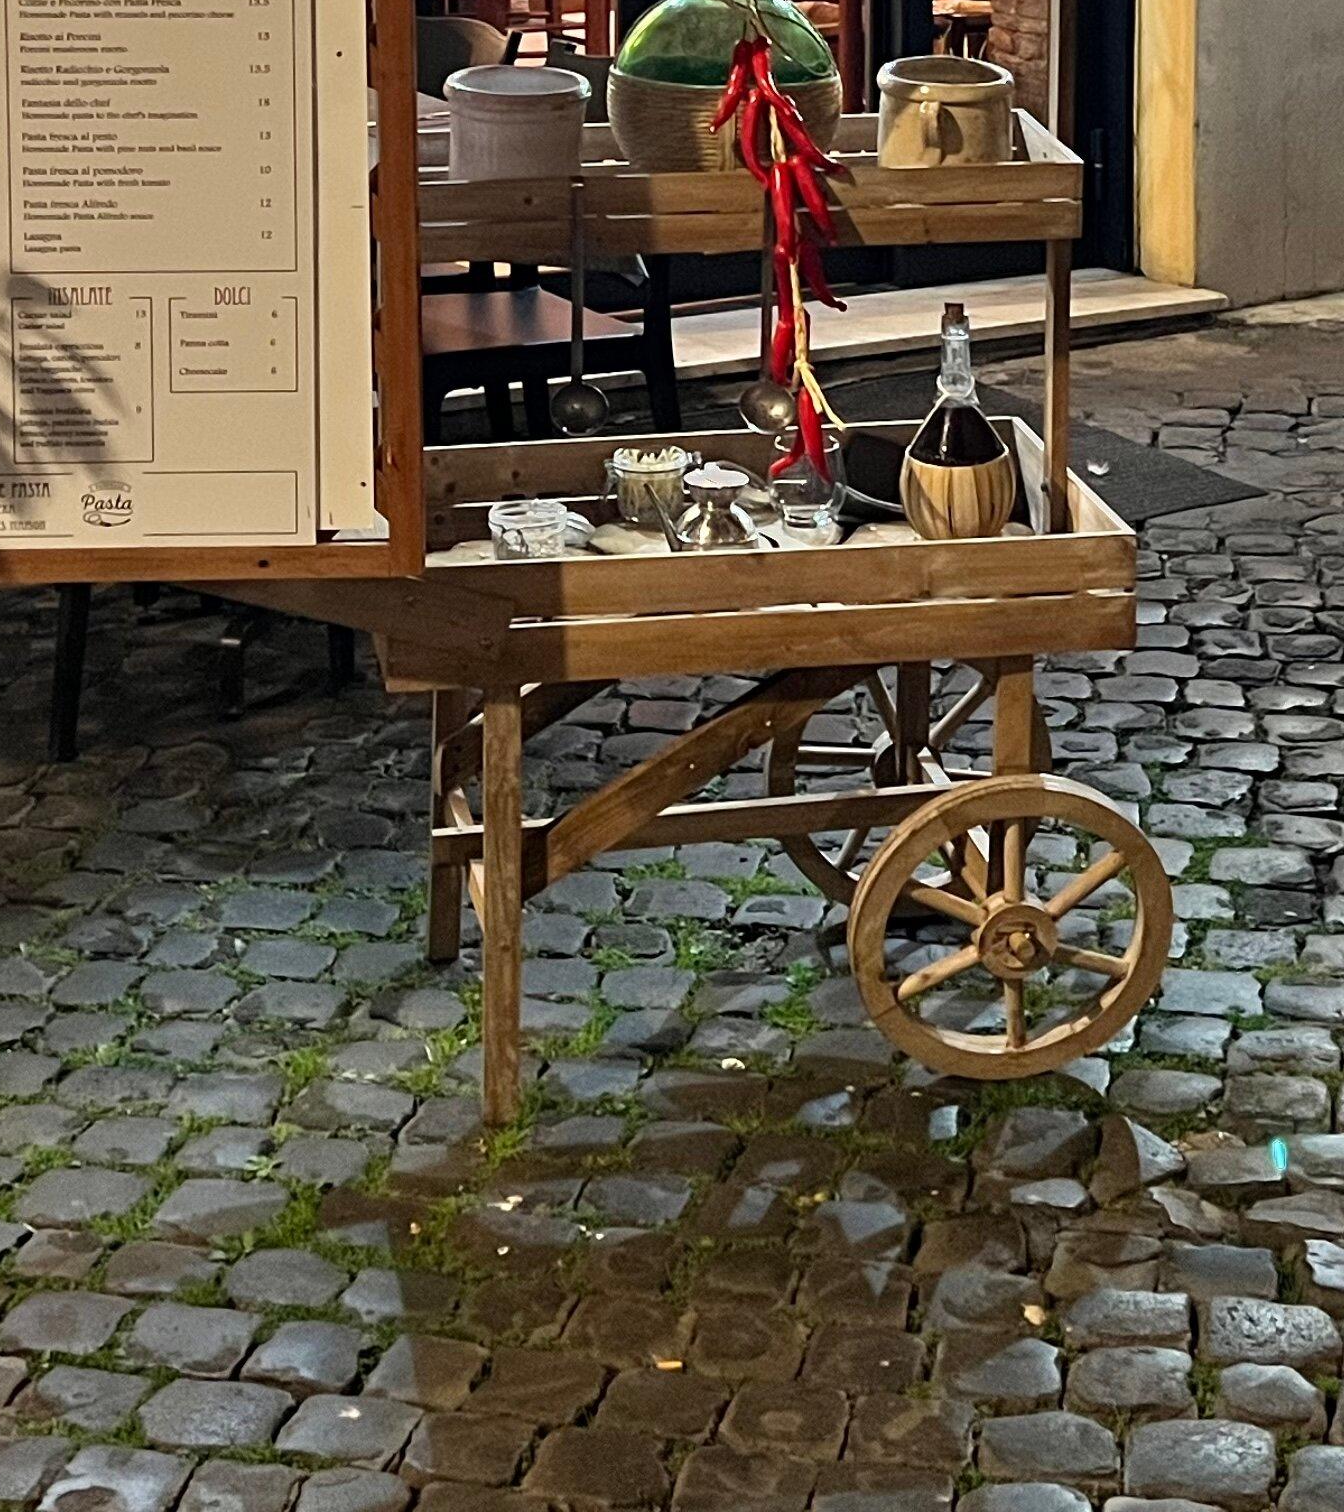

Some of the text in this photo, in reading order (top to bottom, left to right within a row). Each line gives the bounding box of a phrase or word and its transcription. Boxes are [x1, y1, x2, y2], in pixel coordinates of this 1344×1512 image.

[48, 286, 113, 306] INSALATE
[213, 286, 252, 306] DOLCI
[11, 482, 51, 498] PASTA
[81, 493, 133, 512] Pasta
